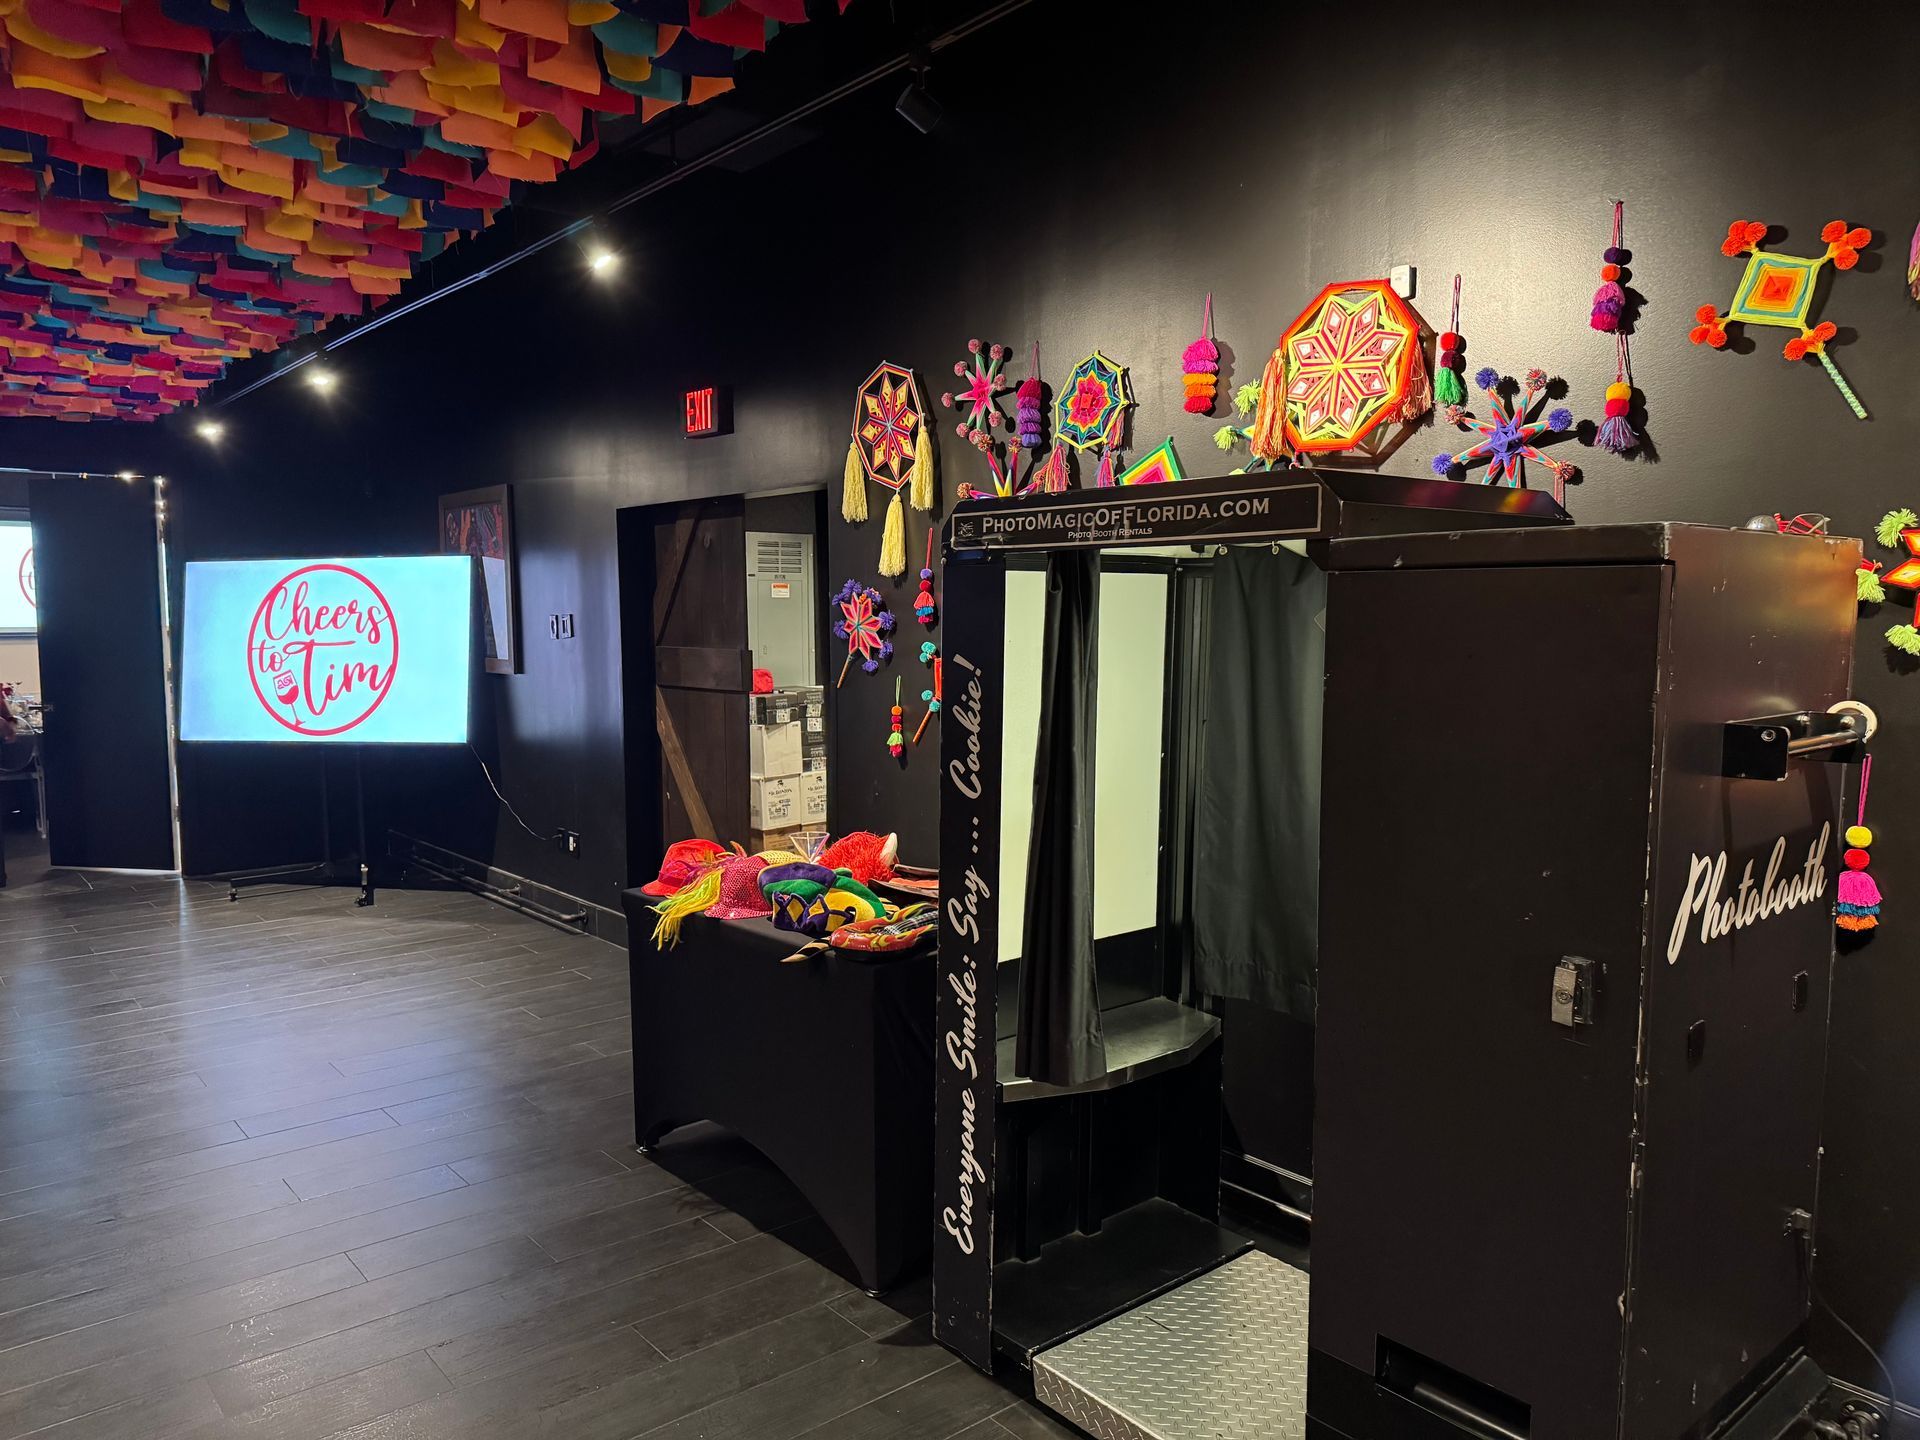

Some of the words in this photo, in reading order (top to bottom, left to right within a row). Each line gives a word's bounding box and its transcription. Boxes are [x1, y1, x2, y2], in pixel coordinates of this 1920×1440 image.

[686, 388, 712, 432] EXIT
[264, 580, 388, 645] Cheers
[253, 639, 285, 673] to
[282, 638, 393, 716] Tim
[950, 653, 982, 799] Cookie!
[947, 864, 990, 945] Say
[1666, 820, 1831, 966] Photobooth
[946, 954, 977, 1080] Smile:
[943, 1087, 986, 1255] Everyone
